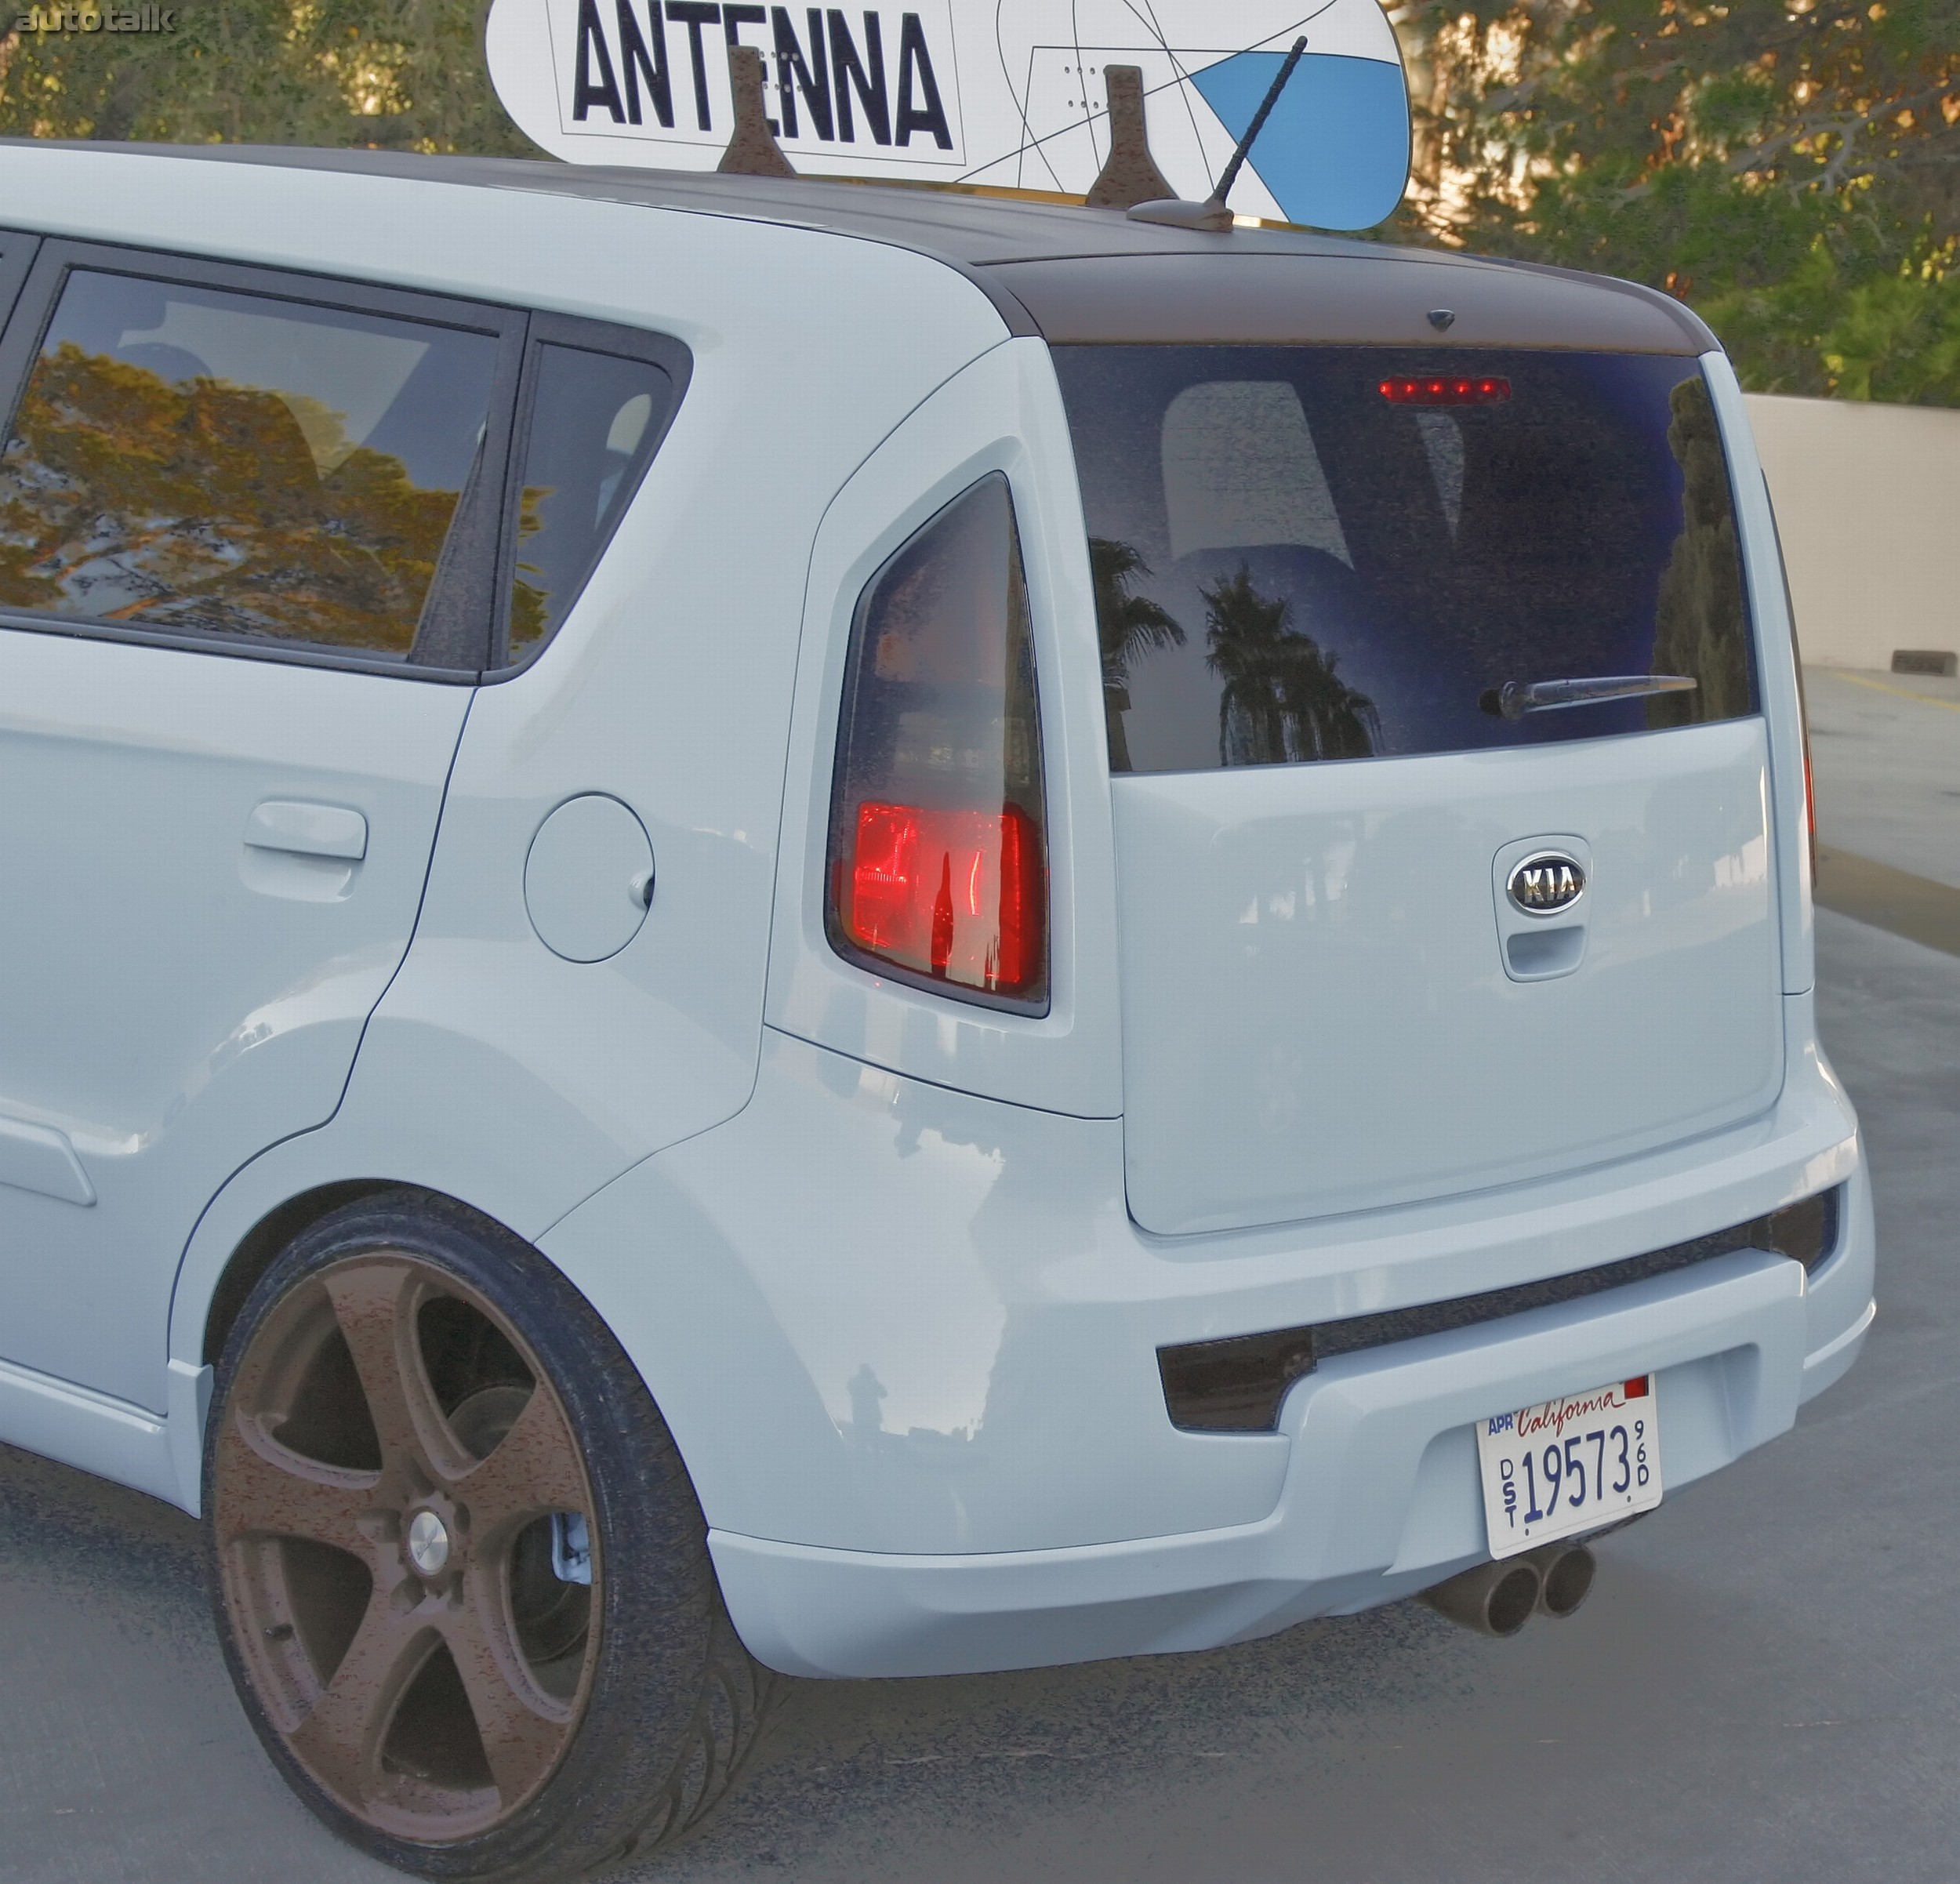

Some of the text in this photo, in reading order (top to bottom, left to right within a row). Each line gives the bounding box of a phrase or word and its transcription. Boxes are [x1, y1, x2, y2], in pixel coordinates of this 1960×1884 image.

[1523, 866, 1576, 903] KIA
[1488, 1413, 1513, 1436] APR
[1518, 1392, 1627, 1438] California
[1523, 1425, 1630, 1524] 19573
